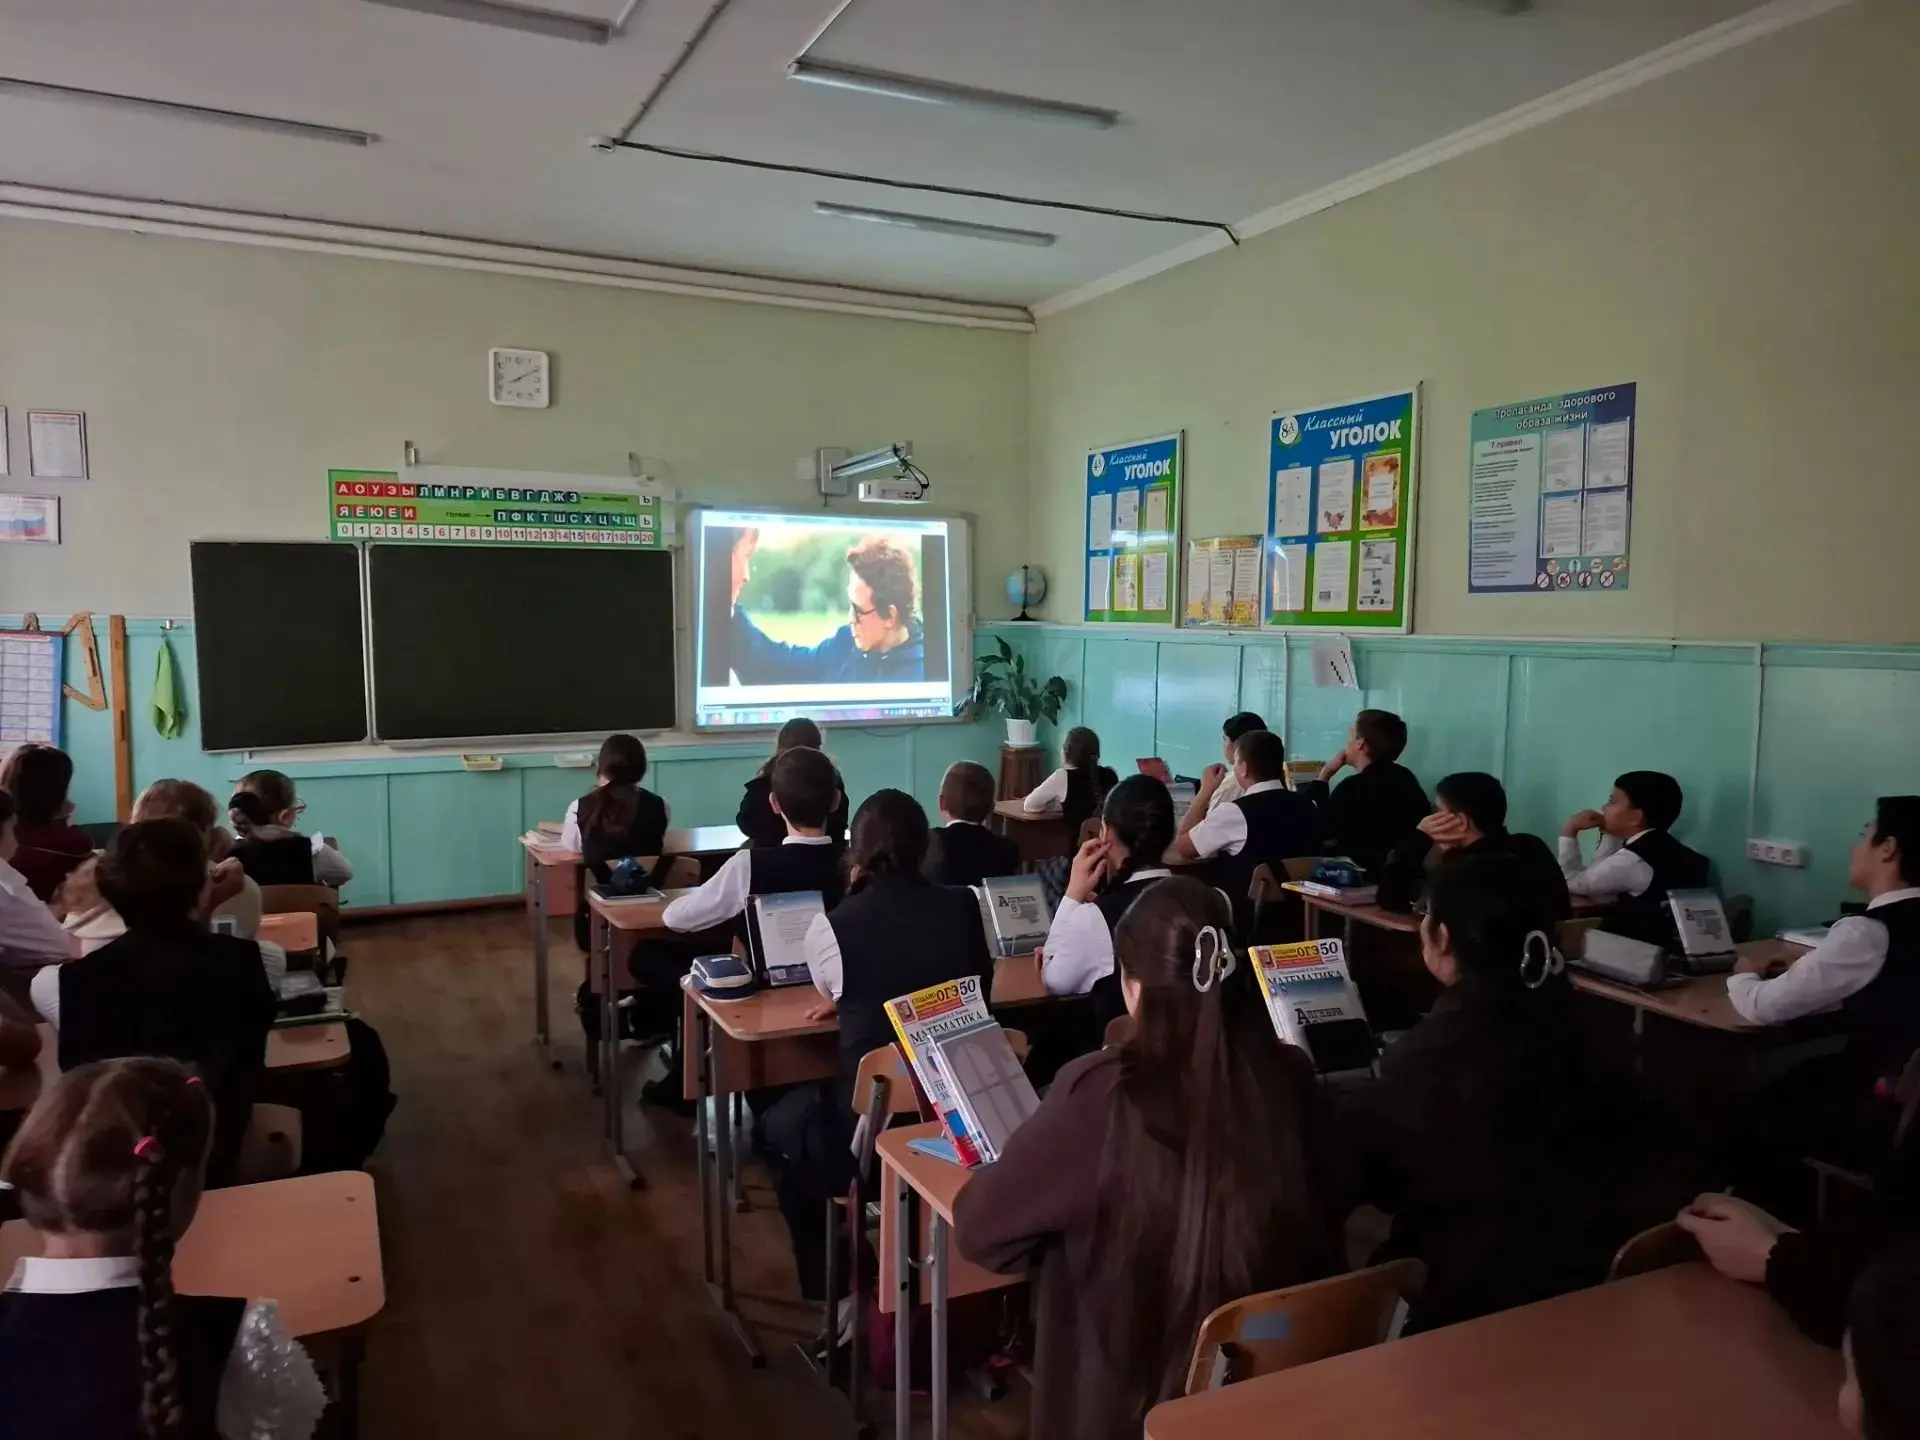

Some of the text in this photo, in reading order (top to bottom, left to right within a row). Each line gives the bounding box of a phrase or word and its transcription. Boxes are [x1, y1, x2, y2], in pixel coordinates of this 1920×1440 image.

[1559, 391, 1616, 408] здорового
[1304, 408, 1364, 431] Классный
[1516, 411, 1588, 429] образа жизни
[1330, 419, 1402, 449] УГОЛОК
[1109, 448, 1148, 466] Классный
[1124, 458, 1171, 481] УГОЛОК
[342, 525, 653, 542] 0 1 2 3 4 5 6 7 8 9 10 11 12 13 14 15 16 17 18 19 20
[1320, 941, 1338, 956] 50
[936, 985, 959, 1001] ОГЭ
[959, 979, 976, 996] 50
[910, 1011, 983, 1045] МАТЕМАТИКА
